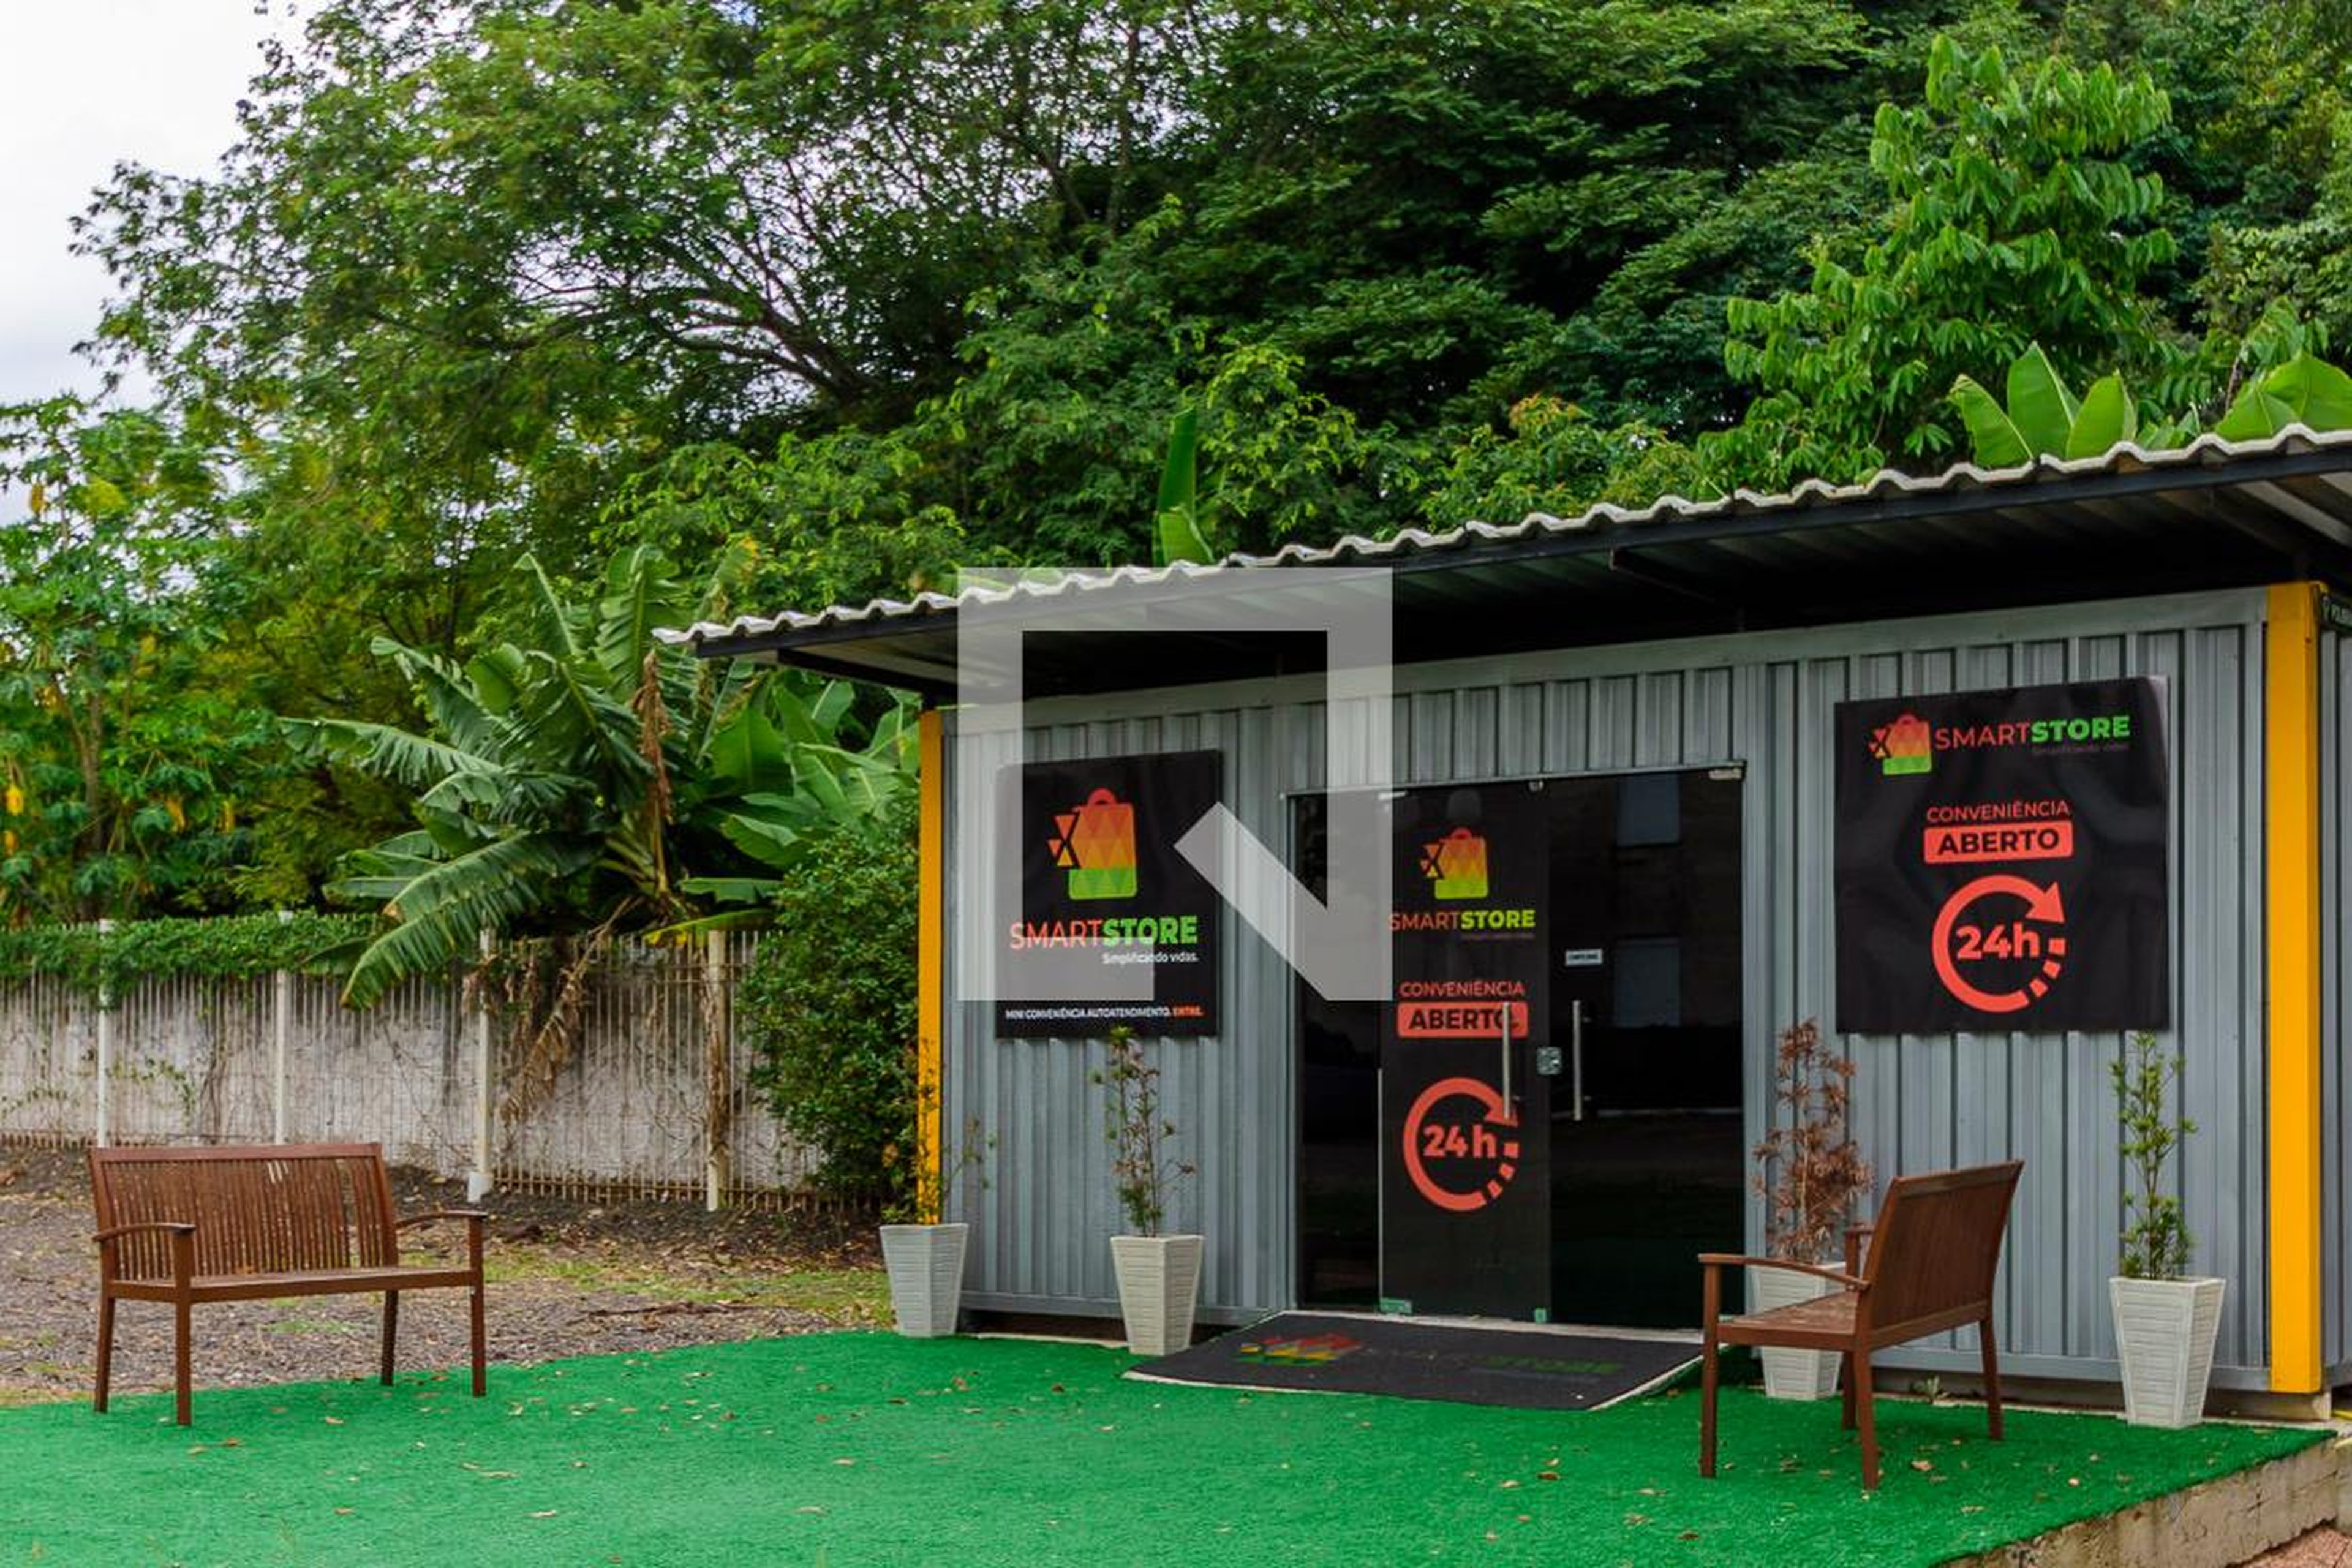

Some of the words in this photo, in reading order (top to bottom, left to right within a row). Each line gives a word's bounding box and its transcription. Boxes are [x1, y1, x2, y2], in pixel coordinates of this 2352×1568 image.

[1935, 715, 2130, 750] SMARTSTORE
[1926, 798, 2071, 822] CONVENIÊNCIA
[1937, 828, 2060, 856] ABERTO
[1010, 916, 1198, 950] SMARTSTORE
[1389, 909, 1536, 932] SMARTSTORE
[1956, 920, 2040, 960] 24h
[1399, 979, 1525, 998] CONVENIÊNCIA
[1423, 1123, 1497, 1159] 24h
